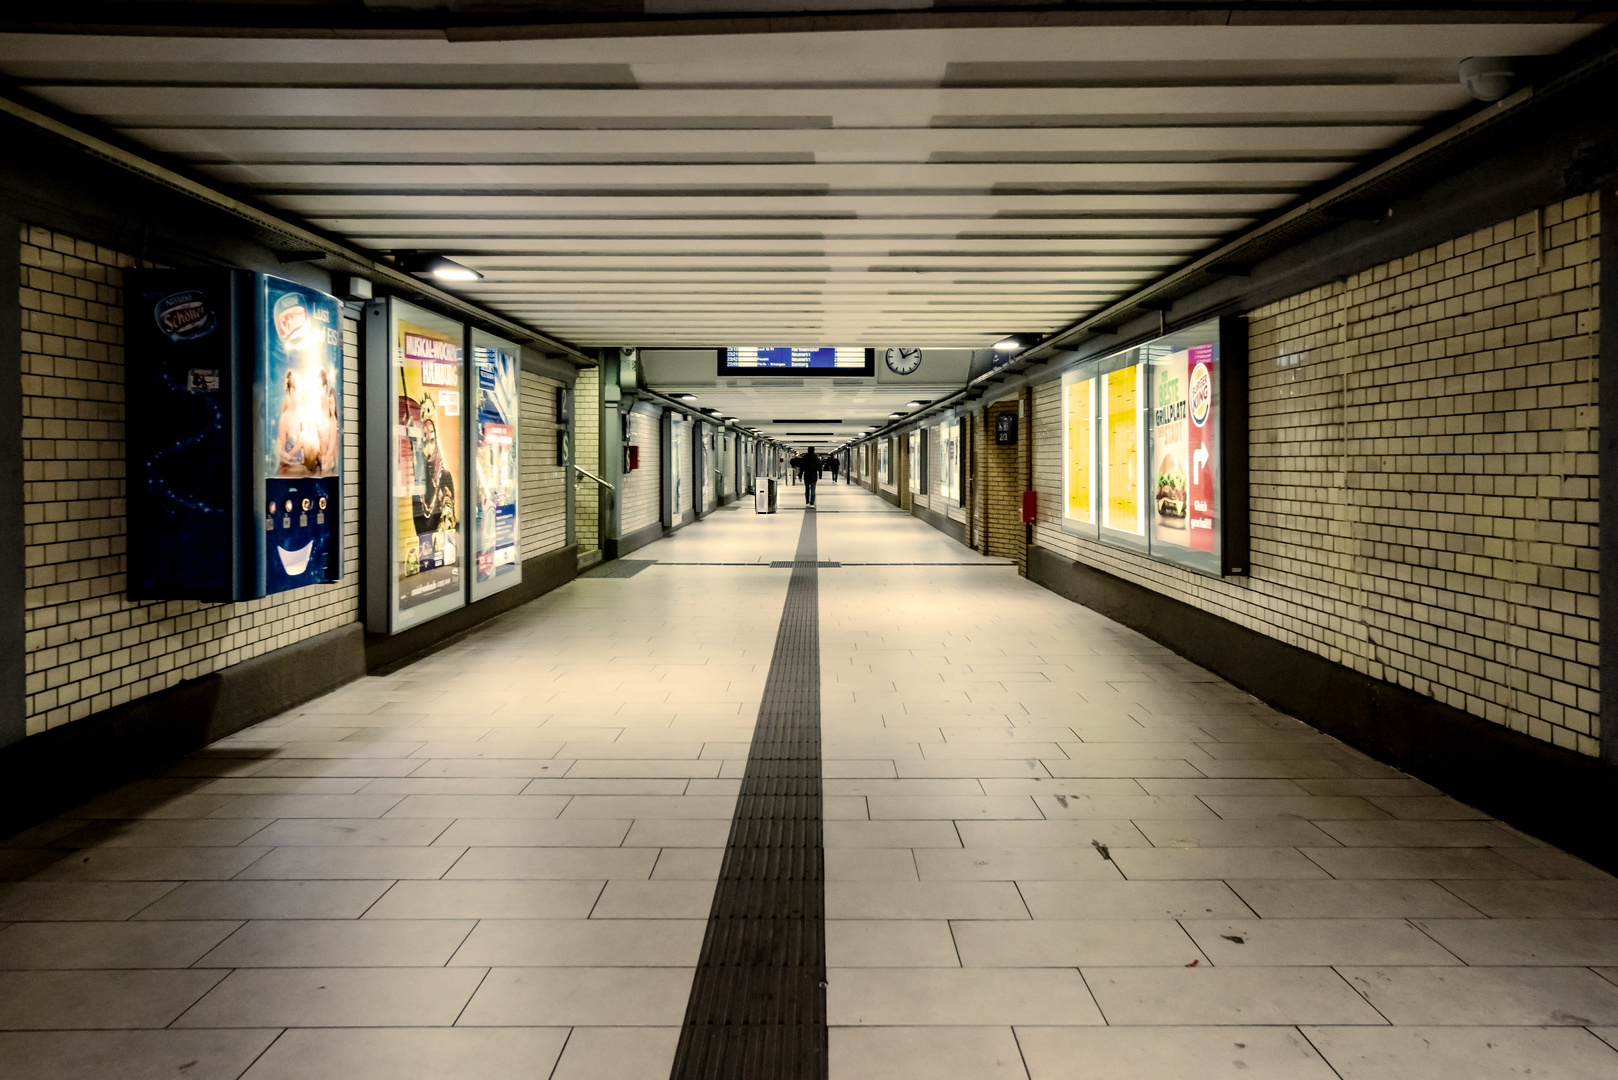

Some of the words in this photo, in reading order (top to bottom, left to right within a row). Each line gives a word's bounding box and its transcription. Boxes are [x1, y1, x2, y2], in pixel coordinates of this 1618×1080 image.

[163, 306, 206, 333] Schöller
[313, 302, 330, 323] Lust
[1192, 384, 1208, 412] KING
[1156, 400, 1187, 427] GRILLPLATZ
